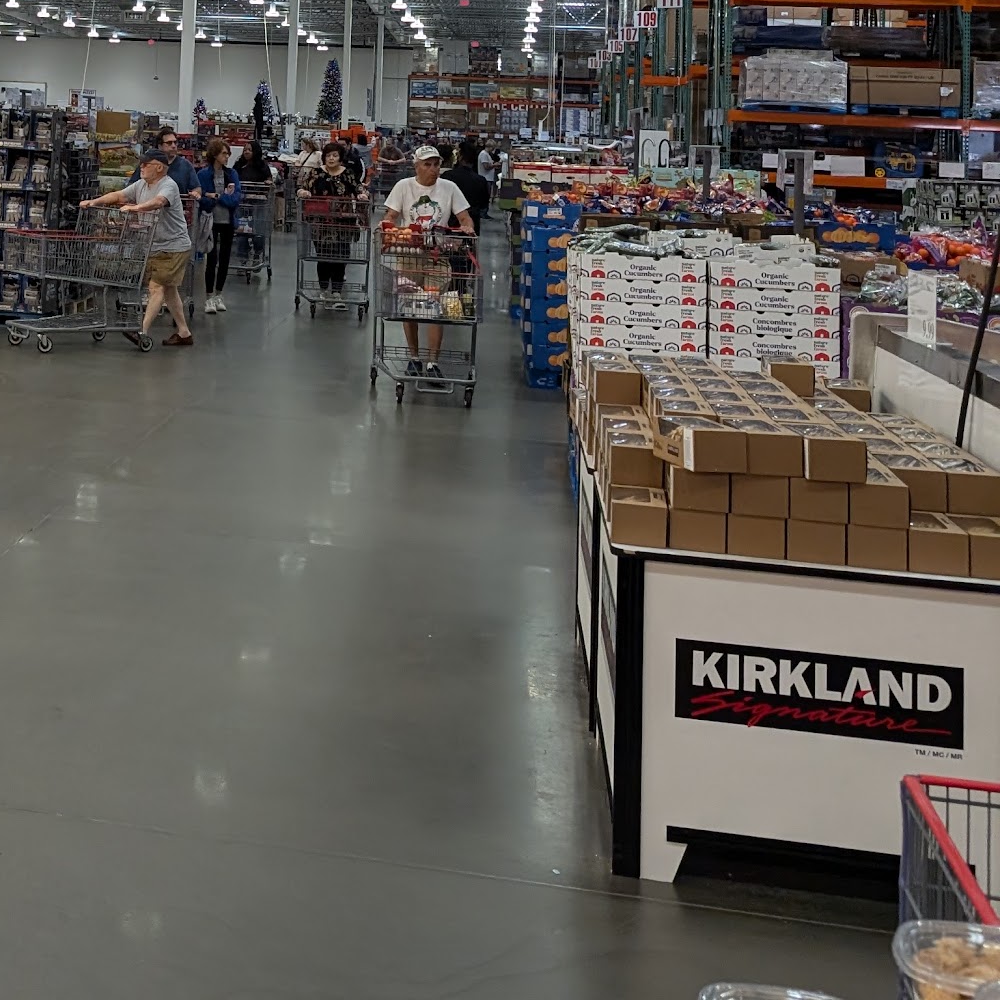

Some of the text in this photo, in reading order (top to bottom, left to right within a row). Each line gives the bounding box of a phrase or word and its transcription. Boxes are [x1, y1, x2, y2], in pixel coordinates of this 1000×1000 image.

[637, 12, 657, 27] 109
[620, 28, 637, 41] 107
[610, 40, 623, 52] 105
[598, 51, 611, 61] 103
[630, 264, 657, 272] Organic
[624, 270, 663, 278] Cucumbers
[761, 272, 789, 280] Organic
[755, 278, 795, 286] Cucumbers
[624, 293, 663, 301] Cucumbers
[761, 295, 789, 303] Organic
[754, 301, 795, 309] Cucumbers
[629, 310, 656, 318] Organic
[623, 316, 662, 324] Cucumbers
[752, 318, 797, 326] Concombres
[756, 325, 793, 333] biologique
[922, 320, 934, 339] 9.99
[623, 339, 662, 347] Cucumbers
[752, 341, 797, 350] Concombres
[692, 650, 952, 712] KIRKLAND
[691, 690, 952, 735] Signature
